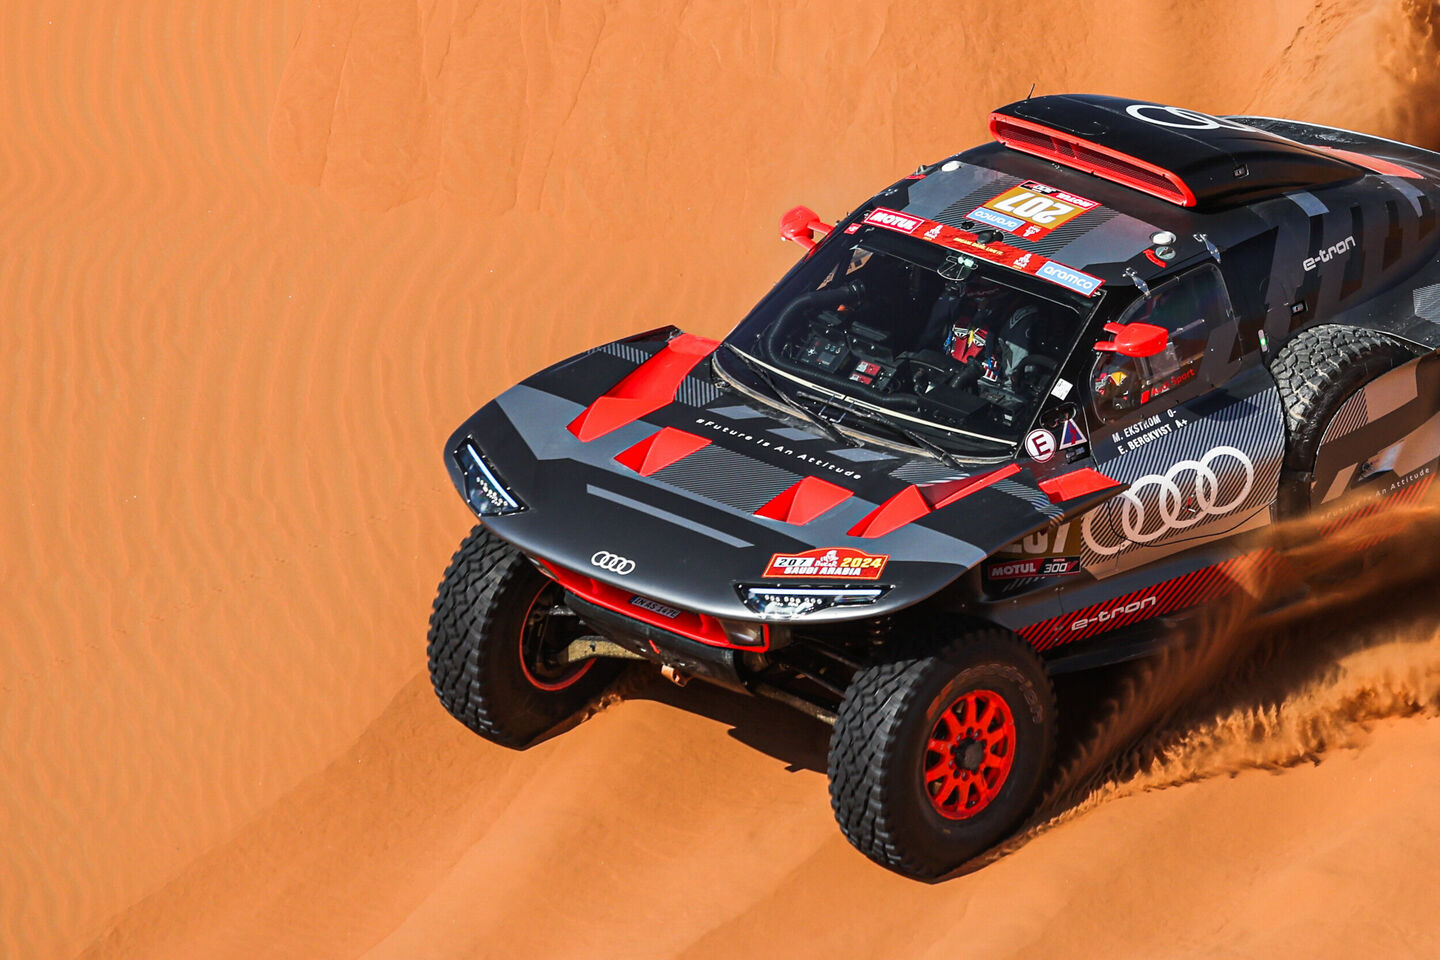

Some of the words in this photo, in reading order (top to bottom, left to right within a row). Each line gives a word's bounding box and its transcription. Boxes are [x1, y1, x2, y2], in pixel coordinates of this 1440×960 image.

[974, 210, 1017, 228] aramco
[993, 192, 1075, 224] 207
[869, 211, 917, 230] MOTUL
[1302, 235, 1356, 272] e-tron
[1043, 265, 1093, 289] aramco
[1170, 368, 1195, 386] Sport
[1031, 434, 1051, 457] E
[1111, 431, 1124, 443] M.
[1117, 445, 1128, 455] E.
[1127, 423, 1172, 450] BERGKVIST
[1175, 418, 1188, 429] A+
[756, 438, 771, 447] Is
[773, 445, 793, 455] An
[797, 453, 862, 480] Attitude
[1390, 467, 1430, 490] Attitude
[778, 558, 807, 566] 207
[840, 557, 883, 569] 2024
[783, 566, 819, 575] SAUDI
[819, 567, 862, 576] ARABIA
[991, 563, 1036, 577] MOTUL
[1071, 596, 1157, 631] e-tron
